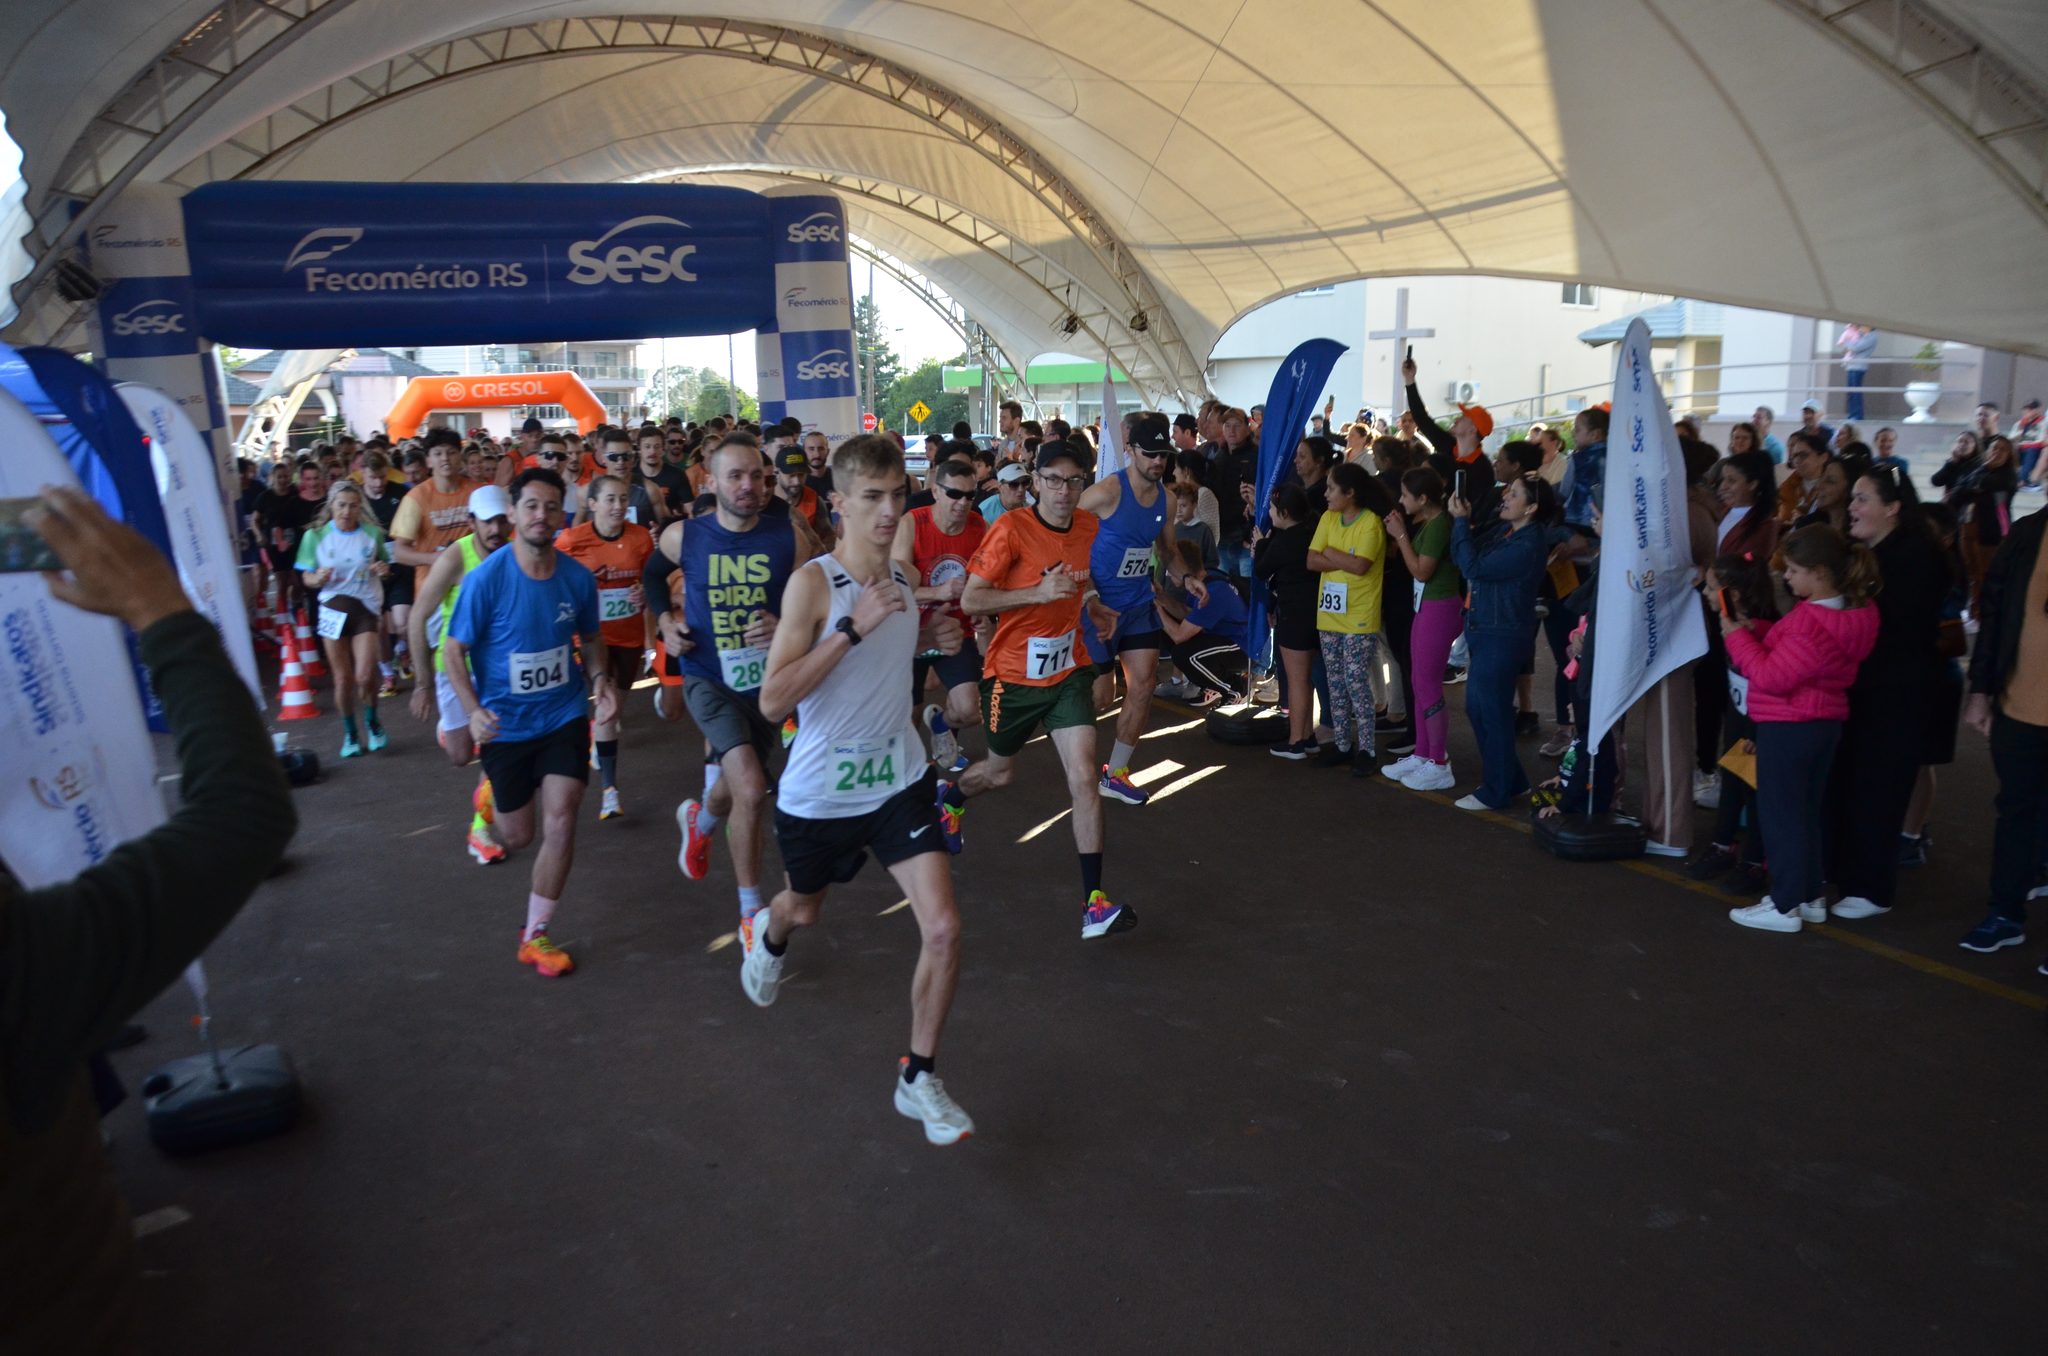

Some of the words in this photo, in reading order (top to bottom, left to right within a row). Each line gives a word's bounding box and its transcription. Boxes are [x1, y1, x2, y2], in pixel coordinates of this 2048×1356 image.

[787, 222, 841, 243] Sesc
[566, 237, 698, 286] Sesc
[305, 263, 481, 293] Fecomércio
[488, 262, 528, 288] RS
[788, 298, 839, 308] Fecomércio
[111, 312, 188, 336] Sesc
[796, 360, 850, 381] Sesc
[470, 380, 549, 398] CRESOL
[1634, 475, 1651, 550] sindicatos
[708, 553, 772, 587] INS
[1122, 558, 1149, 576] 578
[707, 584, 768, 608] PIRA
[1035, 645, 1071, 676] 717
[520, 661, 562, 691] 504
[989, 694, 1002, 734] adidas
[835, 754, 895, 791] 244
